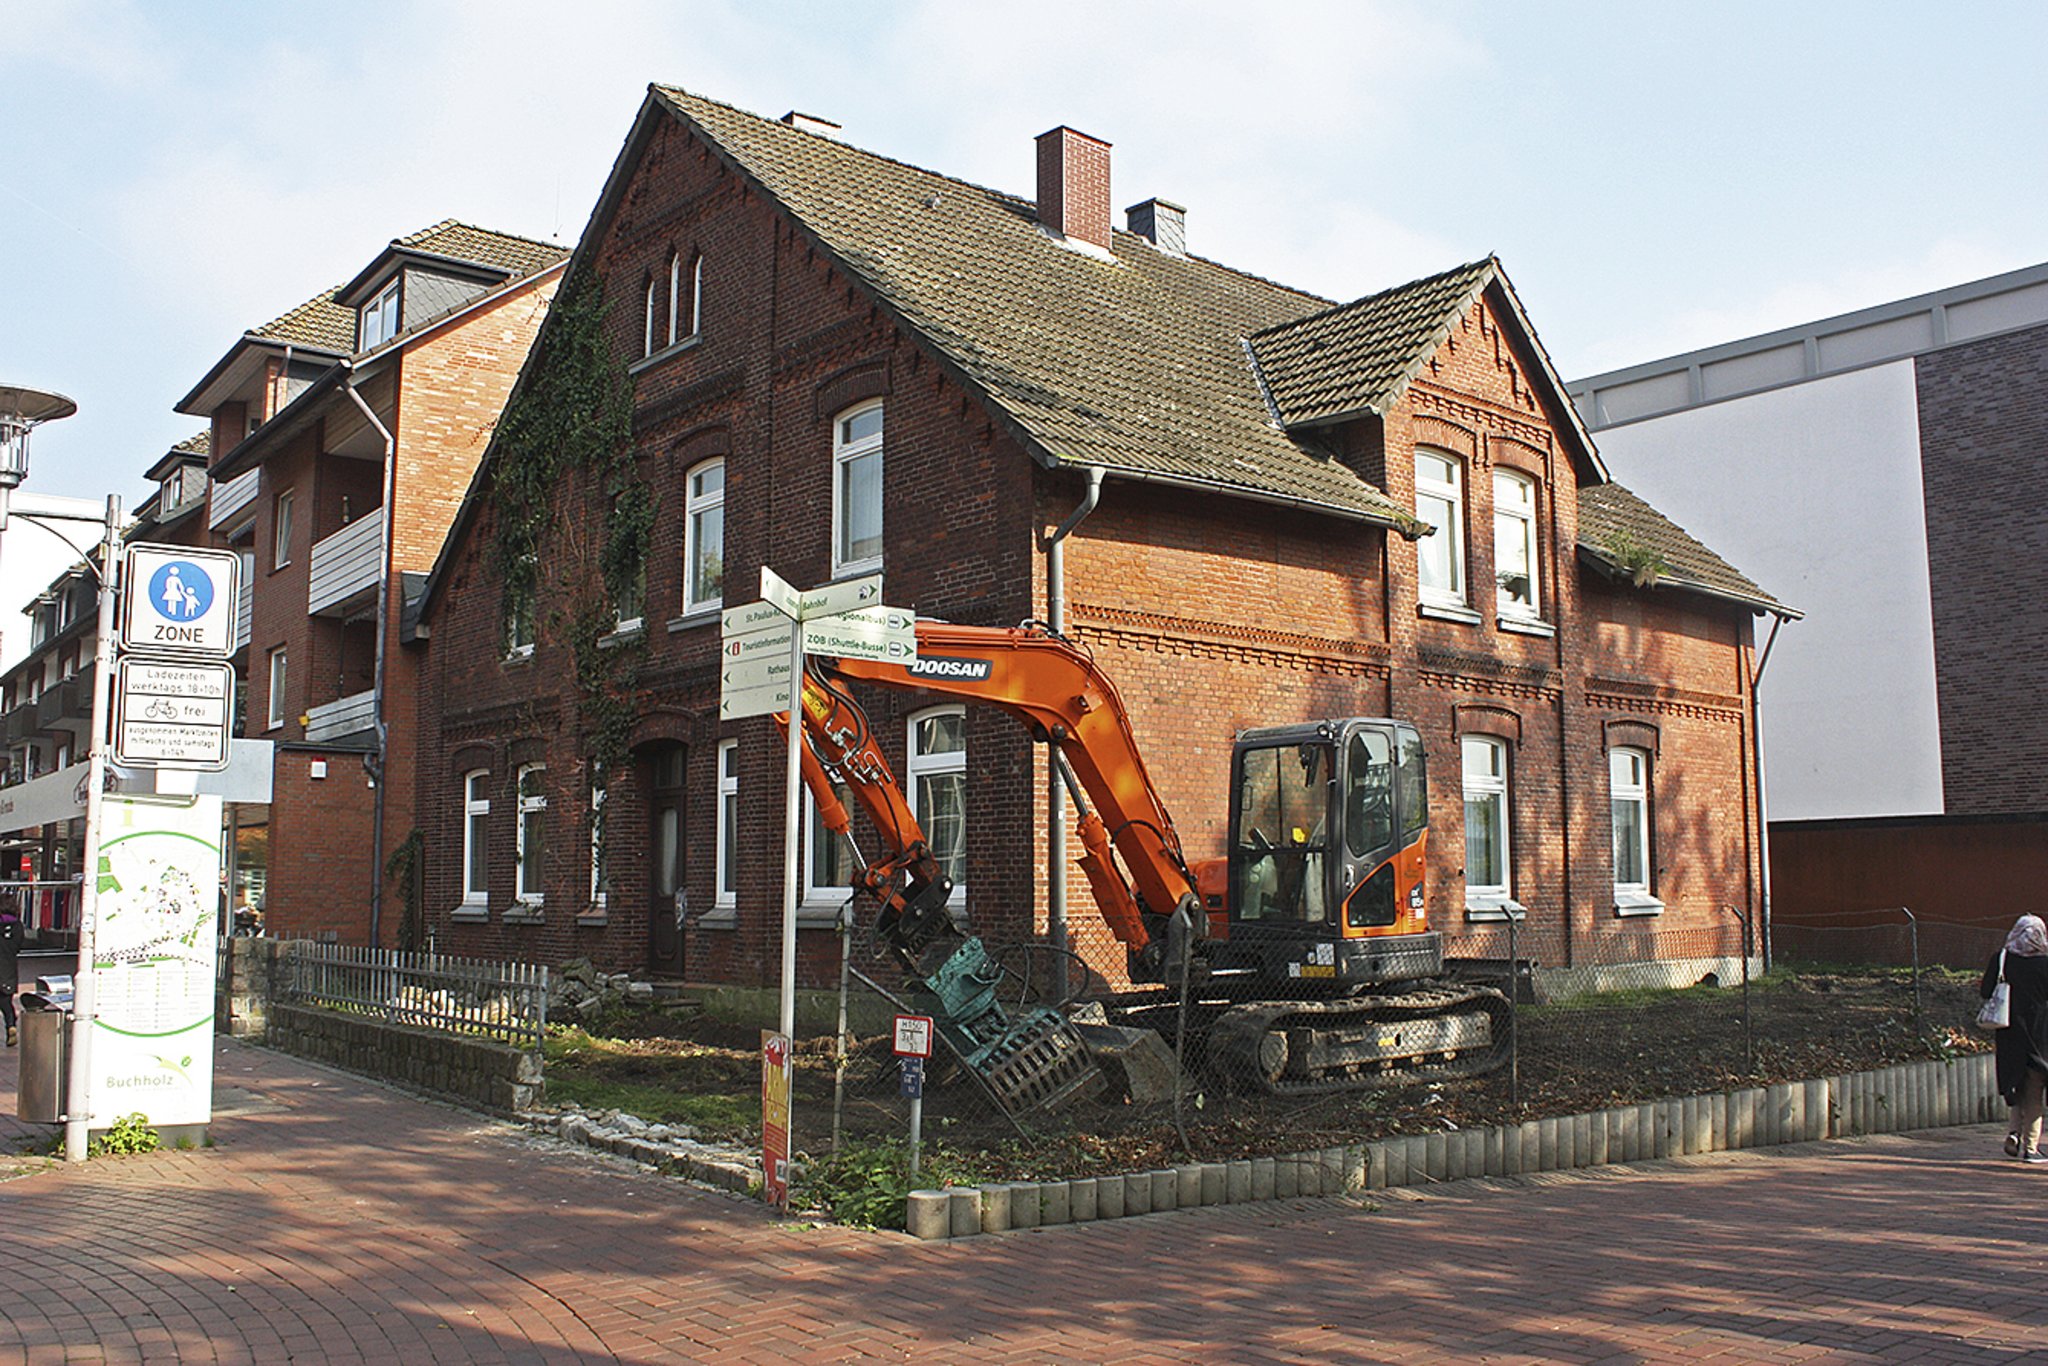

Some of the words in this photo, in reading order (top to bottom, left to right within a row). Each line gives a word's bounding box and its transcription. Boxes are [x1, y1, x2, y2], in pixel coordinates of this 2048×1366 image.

[154, 625, 204, 643] ZONE
[807, 634, 827, 645] ZOB
[767, 664, 790, 675] Rathaus
[911, 659, 987, 677] DOOSAN
[147, 669, 206, 681] Ladezeiten
[131, 682, 183, 693] werktags
[776, 692, 789, 702] Kino
[184, 705, 206, 716] frei
[106, 1074, 174, 1088] Buchholz
